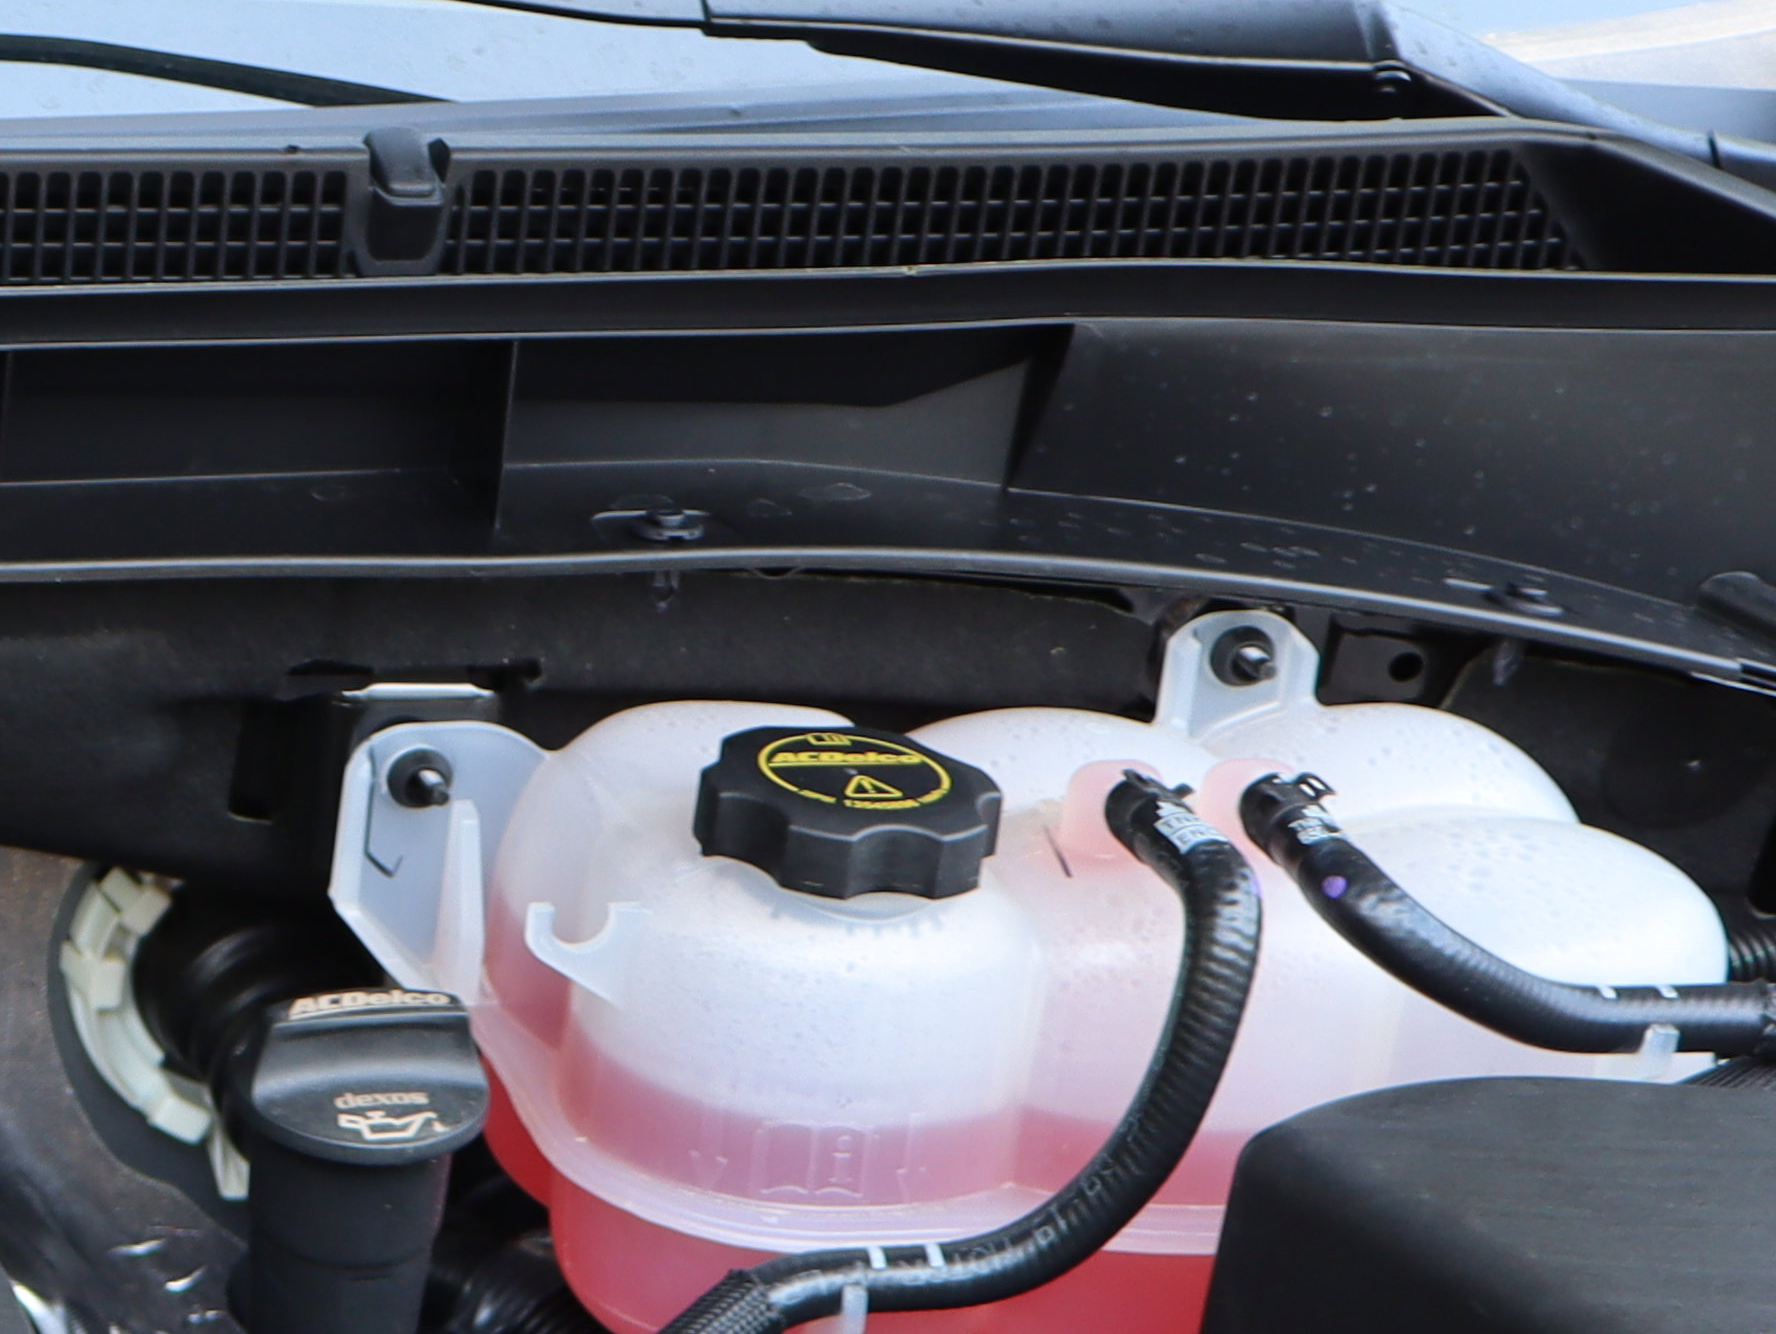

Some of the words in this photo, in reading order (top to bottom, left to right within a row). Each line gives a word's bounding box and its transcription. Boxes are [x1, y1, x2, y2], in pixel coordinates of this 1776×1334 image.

[770, 751, 924, 765] ACDelco
[289, 989, 451, 1017] ACDelco
[333, 1091, 430, 1109] dexos
